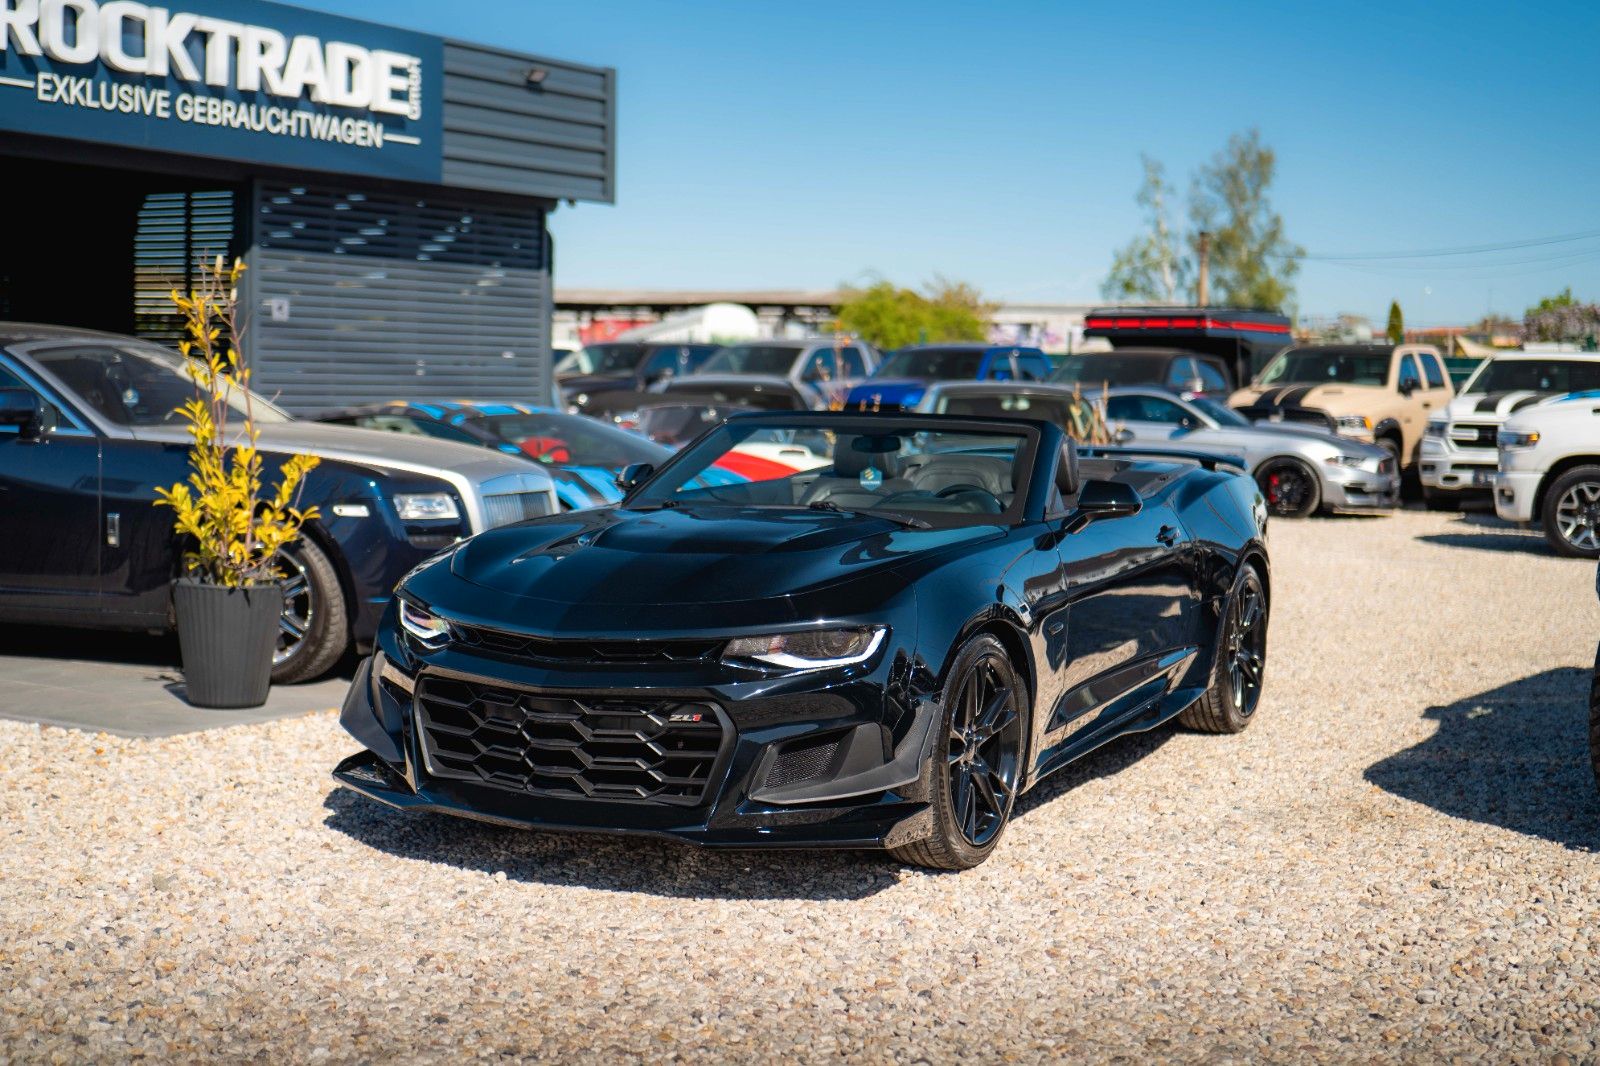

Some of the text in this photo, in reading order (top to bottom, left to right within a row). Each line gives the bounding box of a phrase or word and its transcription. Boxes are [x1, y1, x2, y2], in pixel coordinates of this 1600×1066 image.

[0, 0, 412, 116] ROCKTRADE
[36, 71, 383, 148] EXKLUSIVE GEBRAUCHTWAGEN
